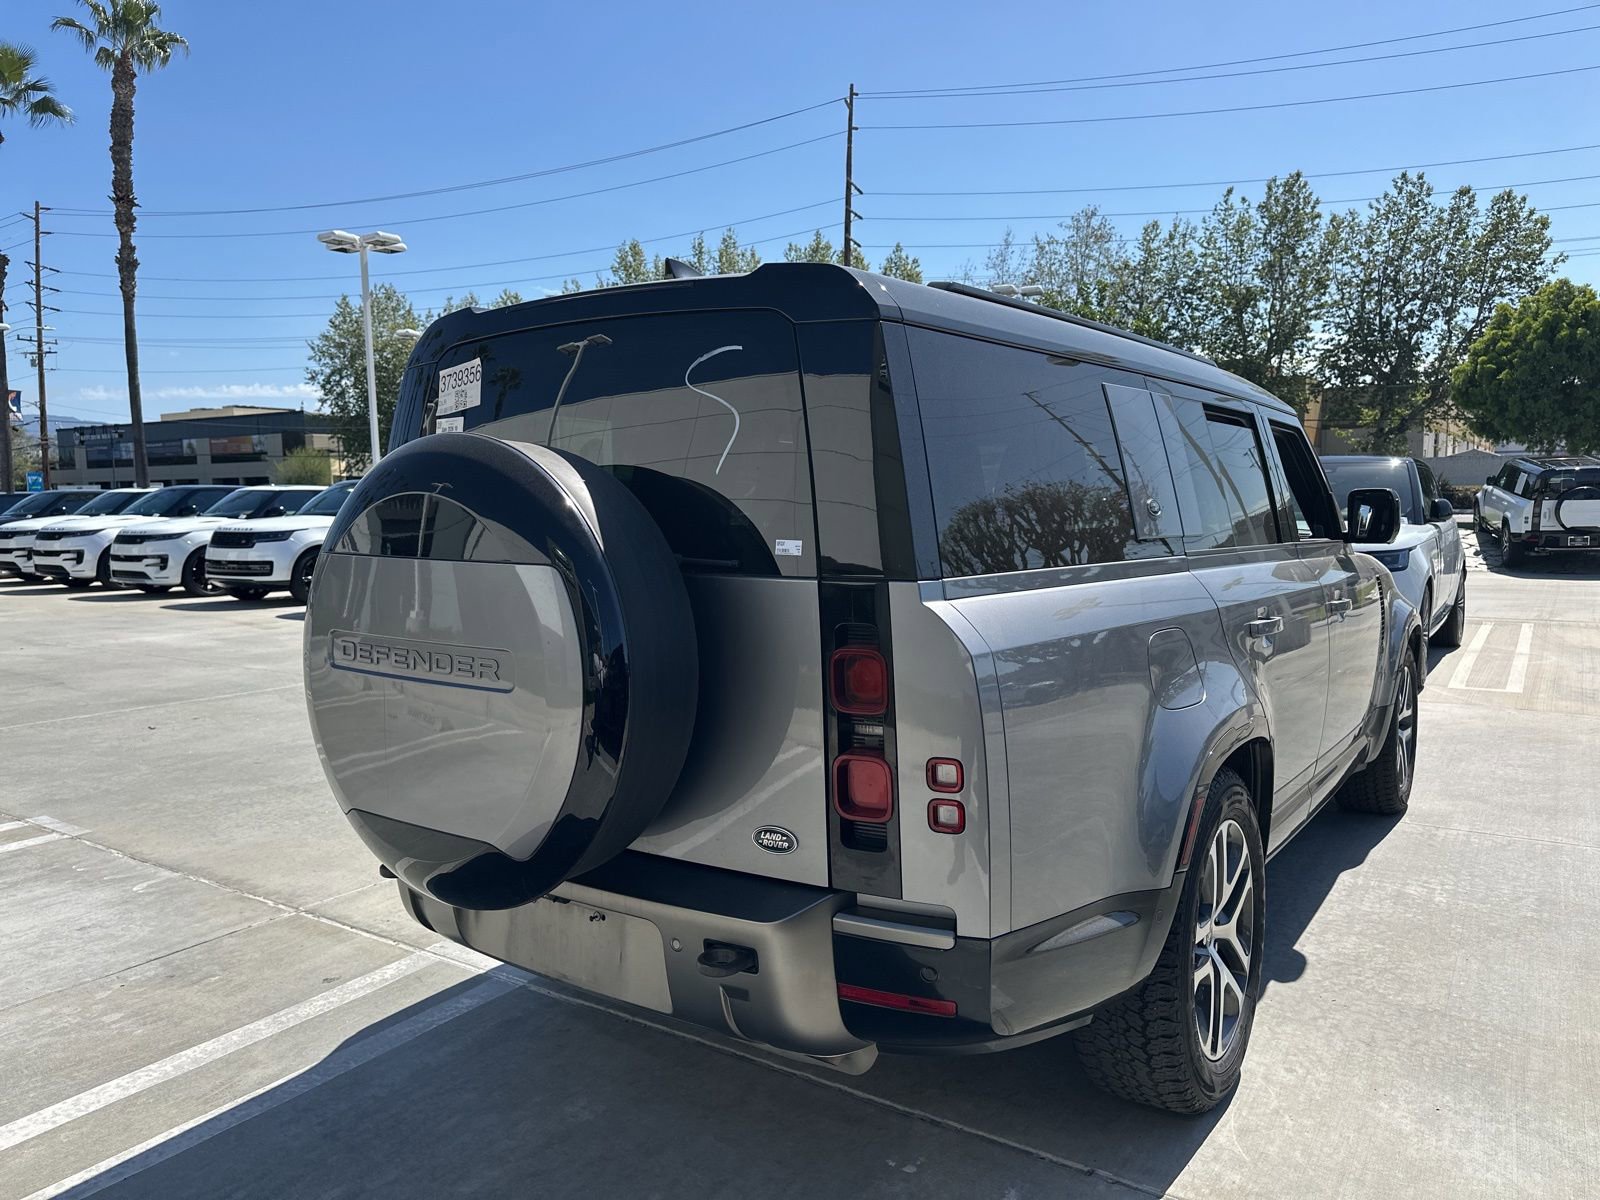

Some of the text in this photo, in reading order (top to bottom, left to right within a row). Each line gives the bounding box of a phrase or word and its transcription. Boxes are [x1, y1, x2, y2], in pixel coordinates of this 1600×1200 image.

[440, 363, 481, 393] 3739356
[340, 639, 501, 681] DEFENDER
[760, 831, 782, 840] LAND
[762, 839, 789, 849] ROVER
